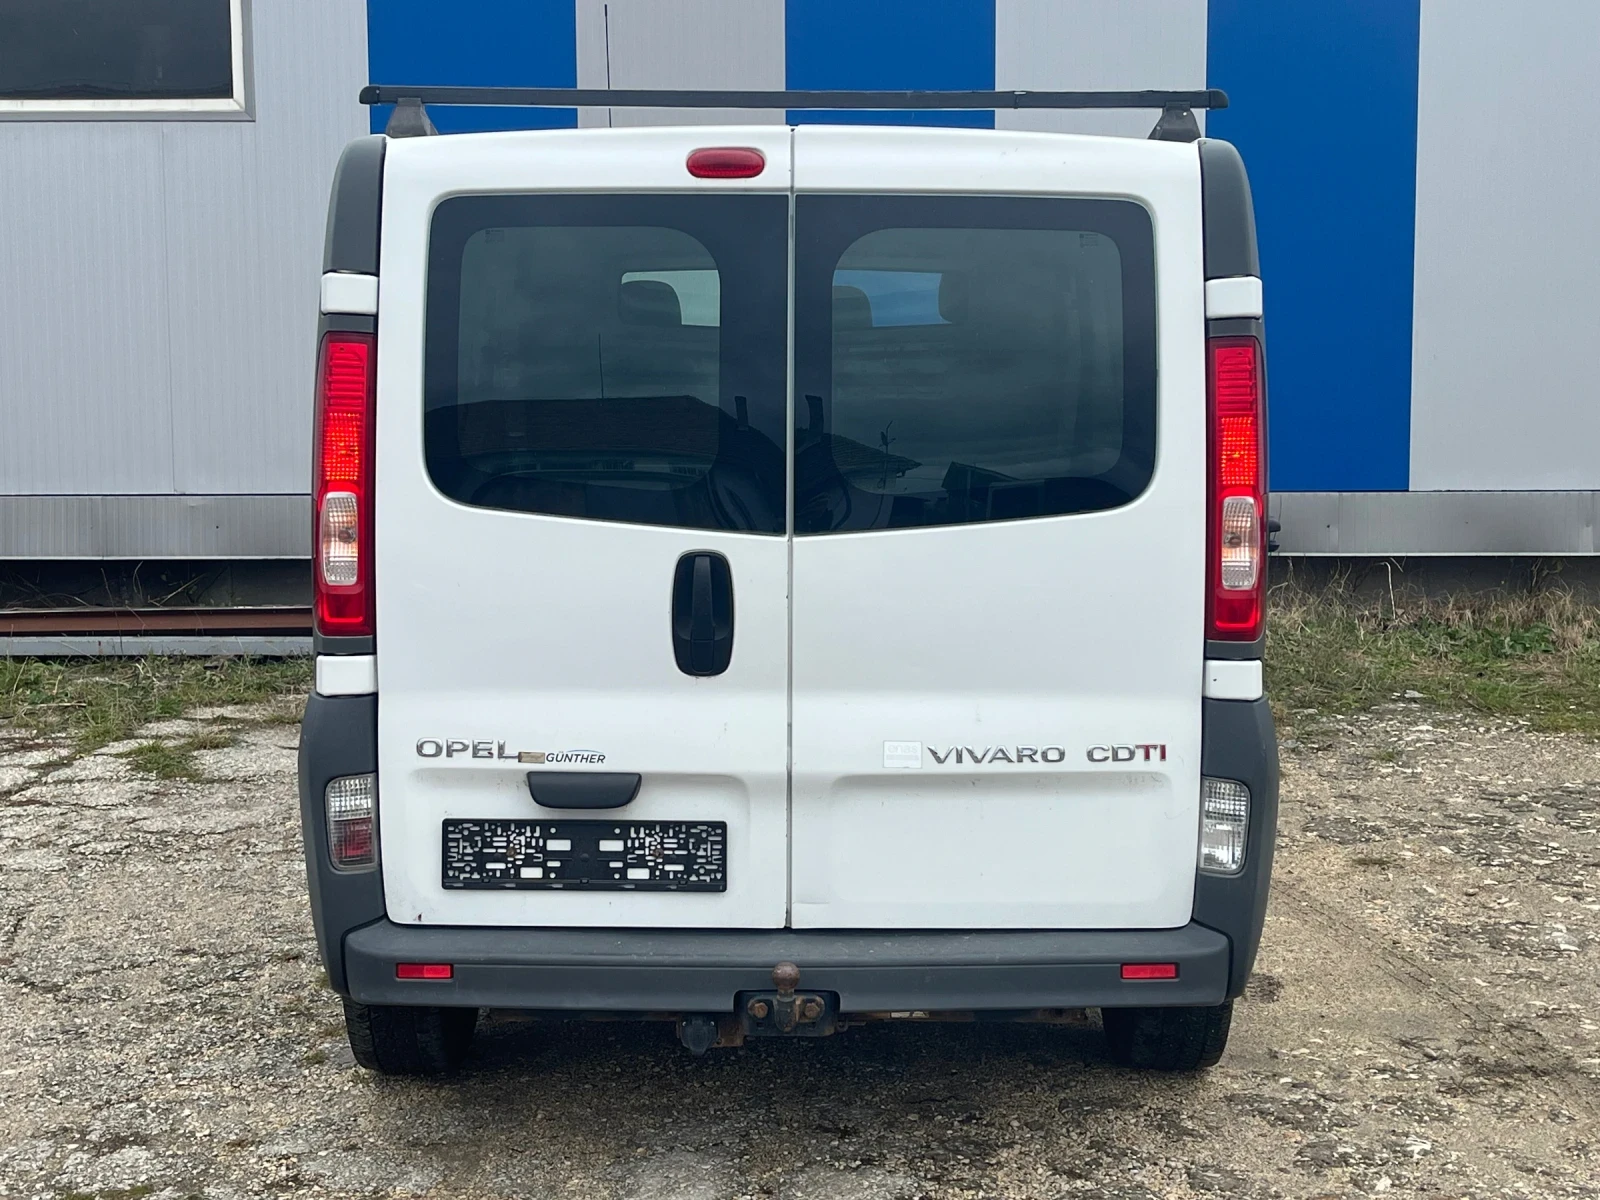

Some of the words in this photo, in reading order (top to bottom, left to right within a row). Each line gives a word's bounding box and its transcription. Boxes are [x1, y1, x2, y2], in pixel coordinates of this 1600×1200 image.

[416, 737, 519, 759] OPEL
[545, 751, 606, 764] GÜNTHER
[926, 744, 1066, 764] VIVARO
[1086, 744, 1167, 762] CDTI
